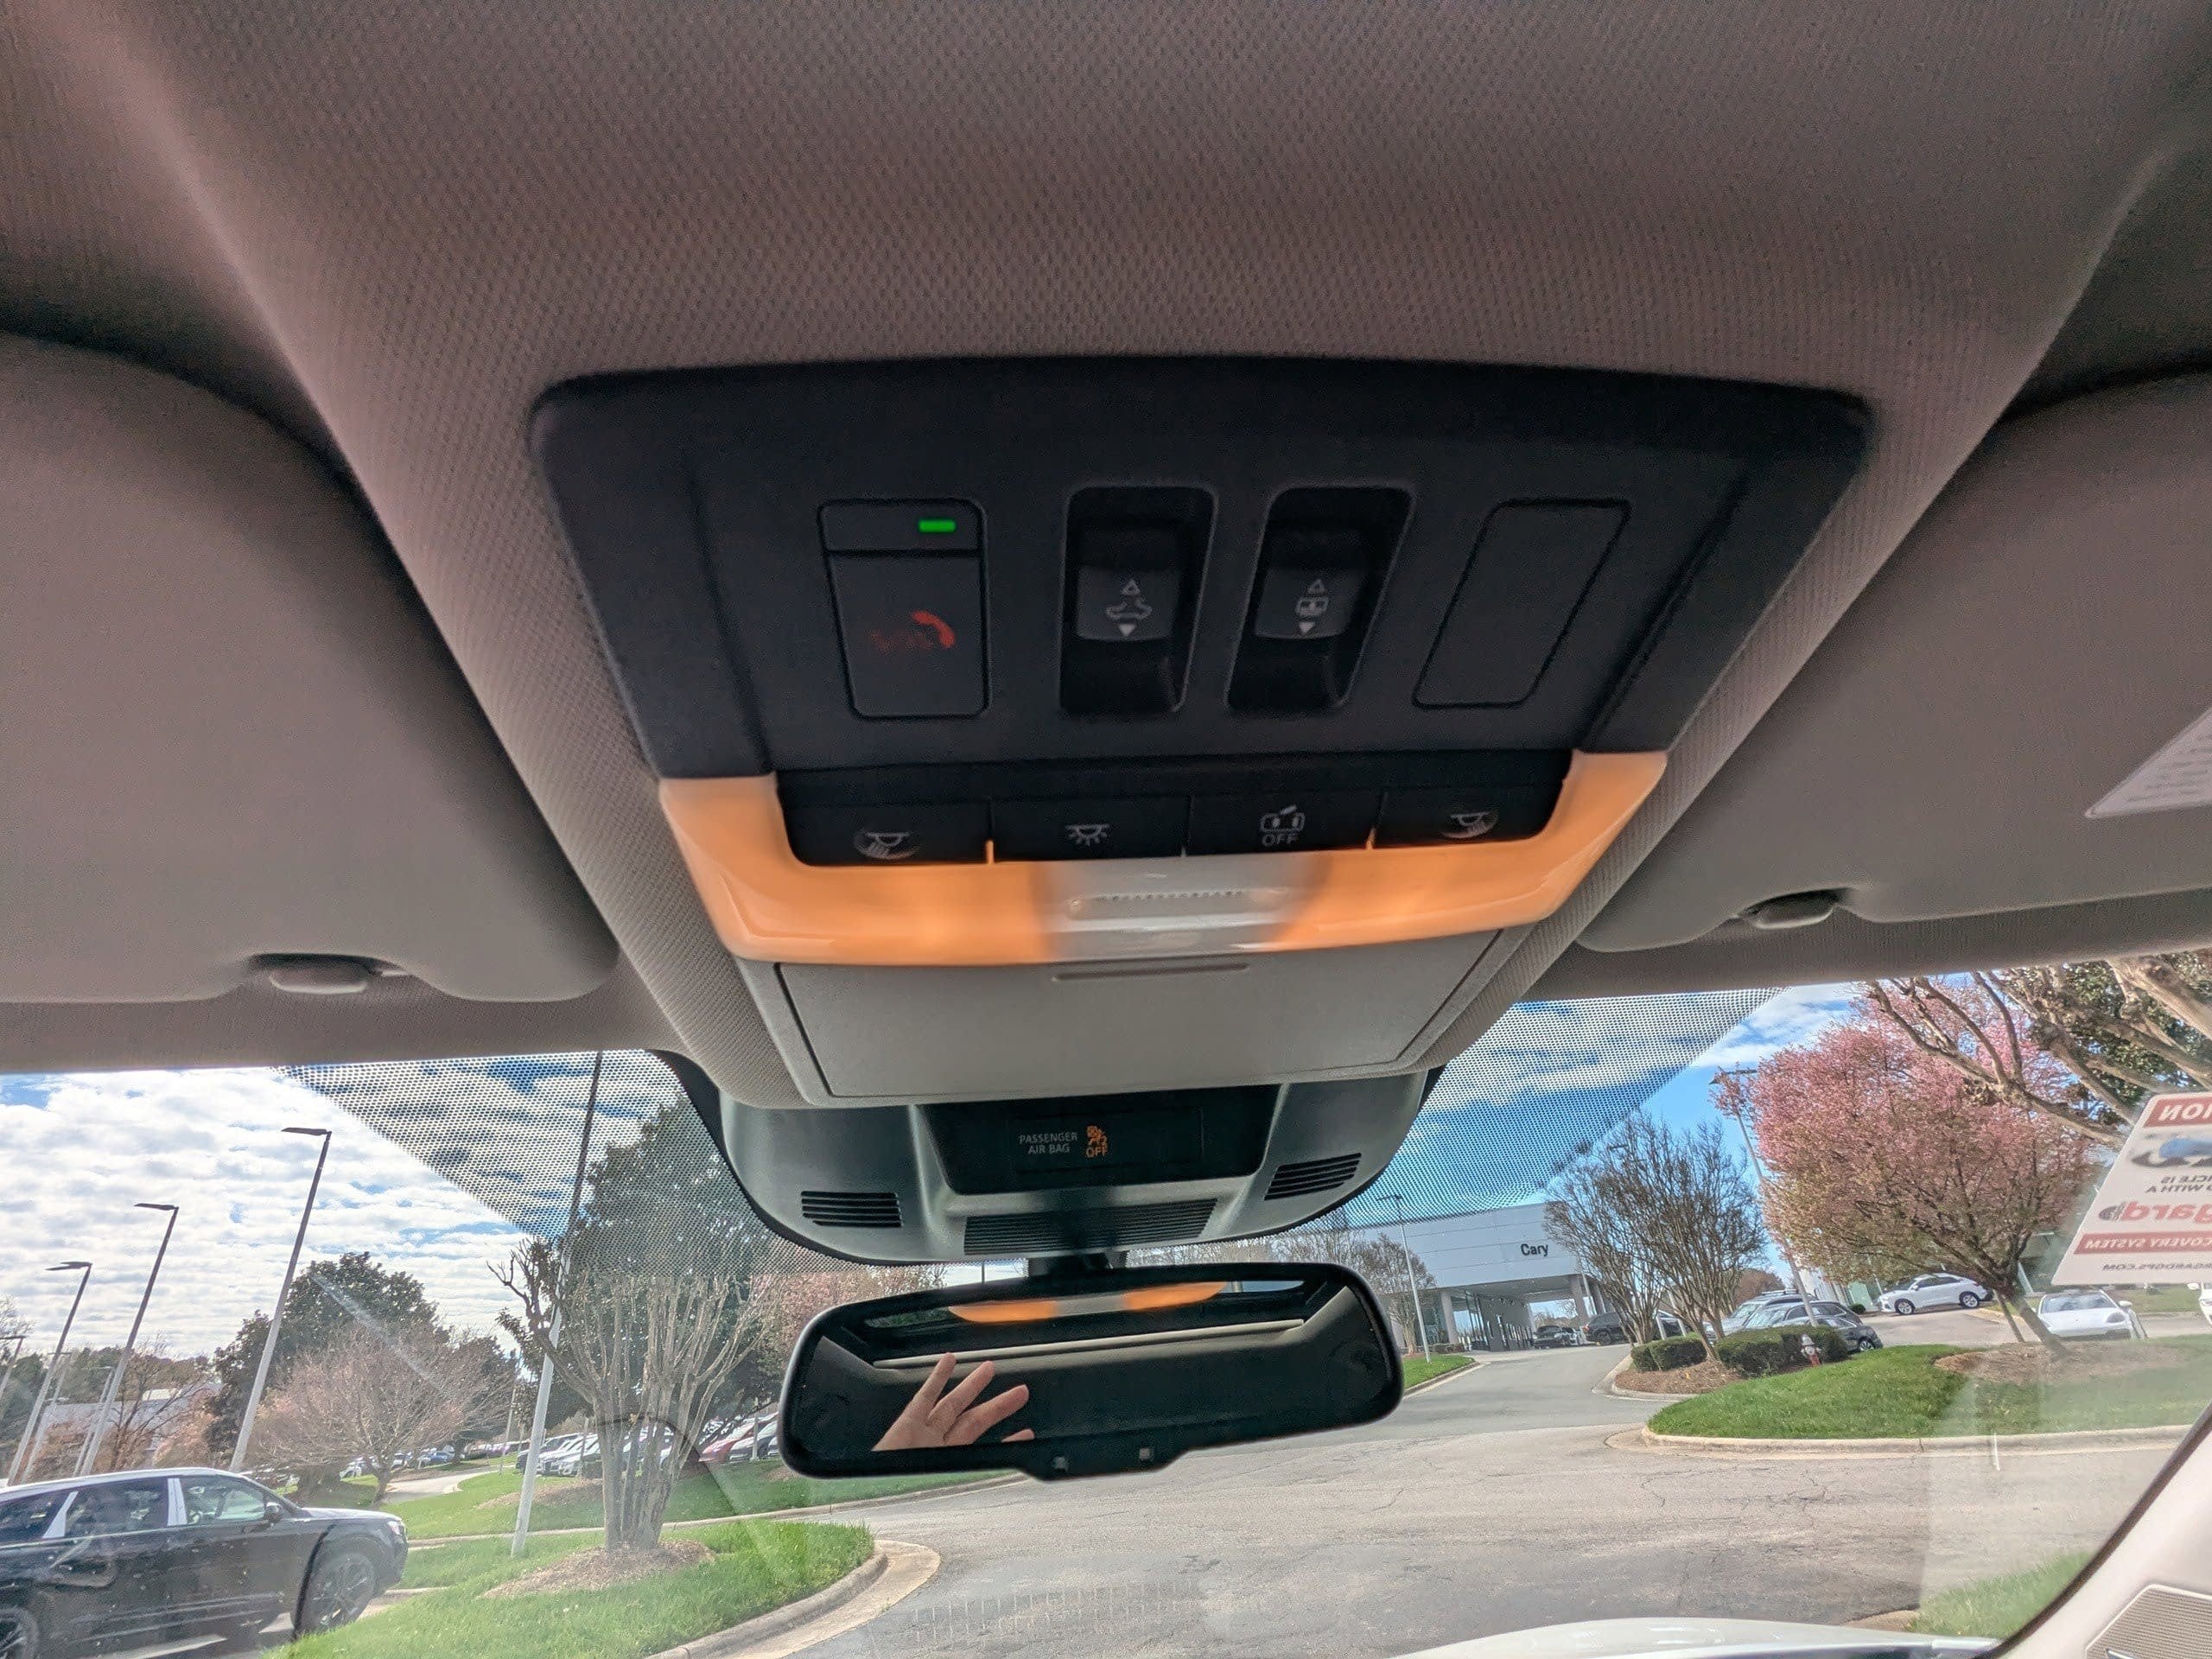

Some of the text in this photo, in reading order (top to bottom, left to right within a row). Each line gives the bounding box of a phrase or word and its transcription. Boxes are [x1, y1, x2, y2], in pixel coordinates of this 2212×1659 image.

[1262, 833, 1298, 847] OFF
[1020, 1132, 1077, 1144] PASSENGER
[1027, 1143, 1071, 1154] AIR BAG
[1086, 1147, 1107, 1158] OFF
[1521, 1243, 1548, 1257] Cary
